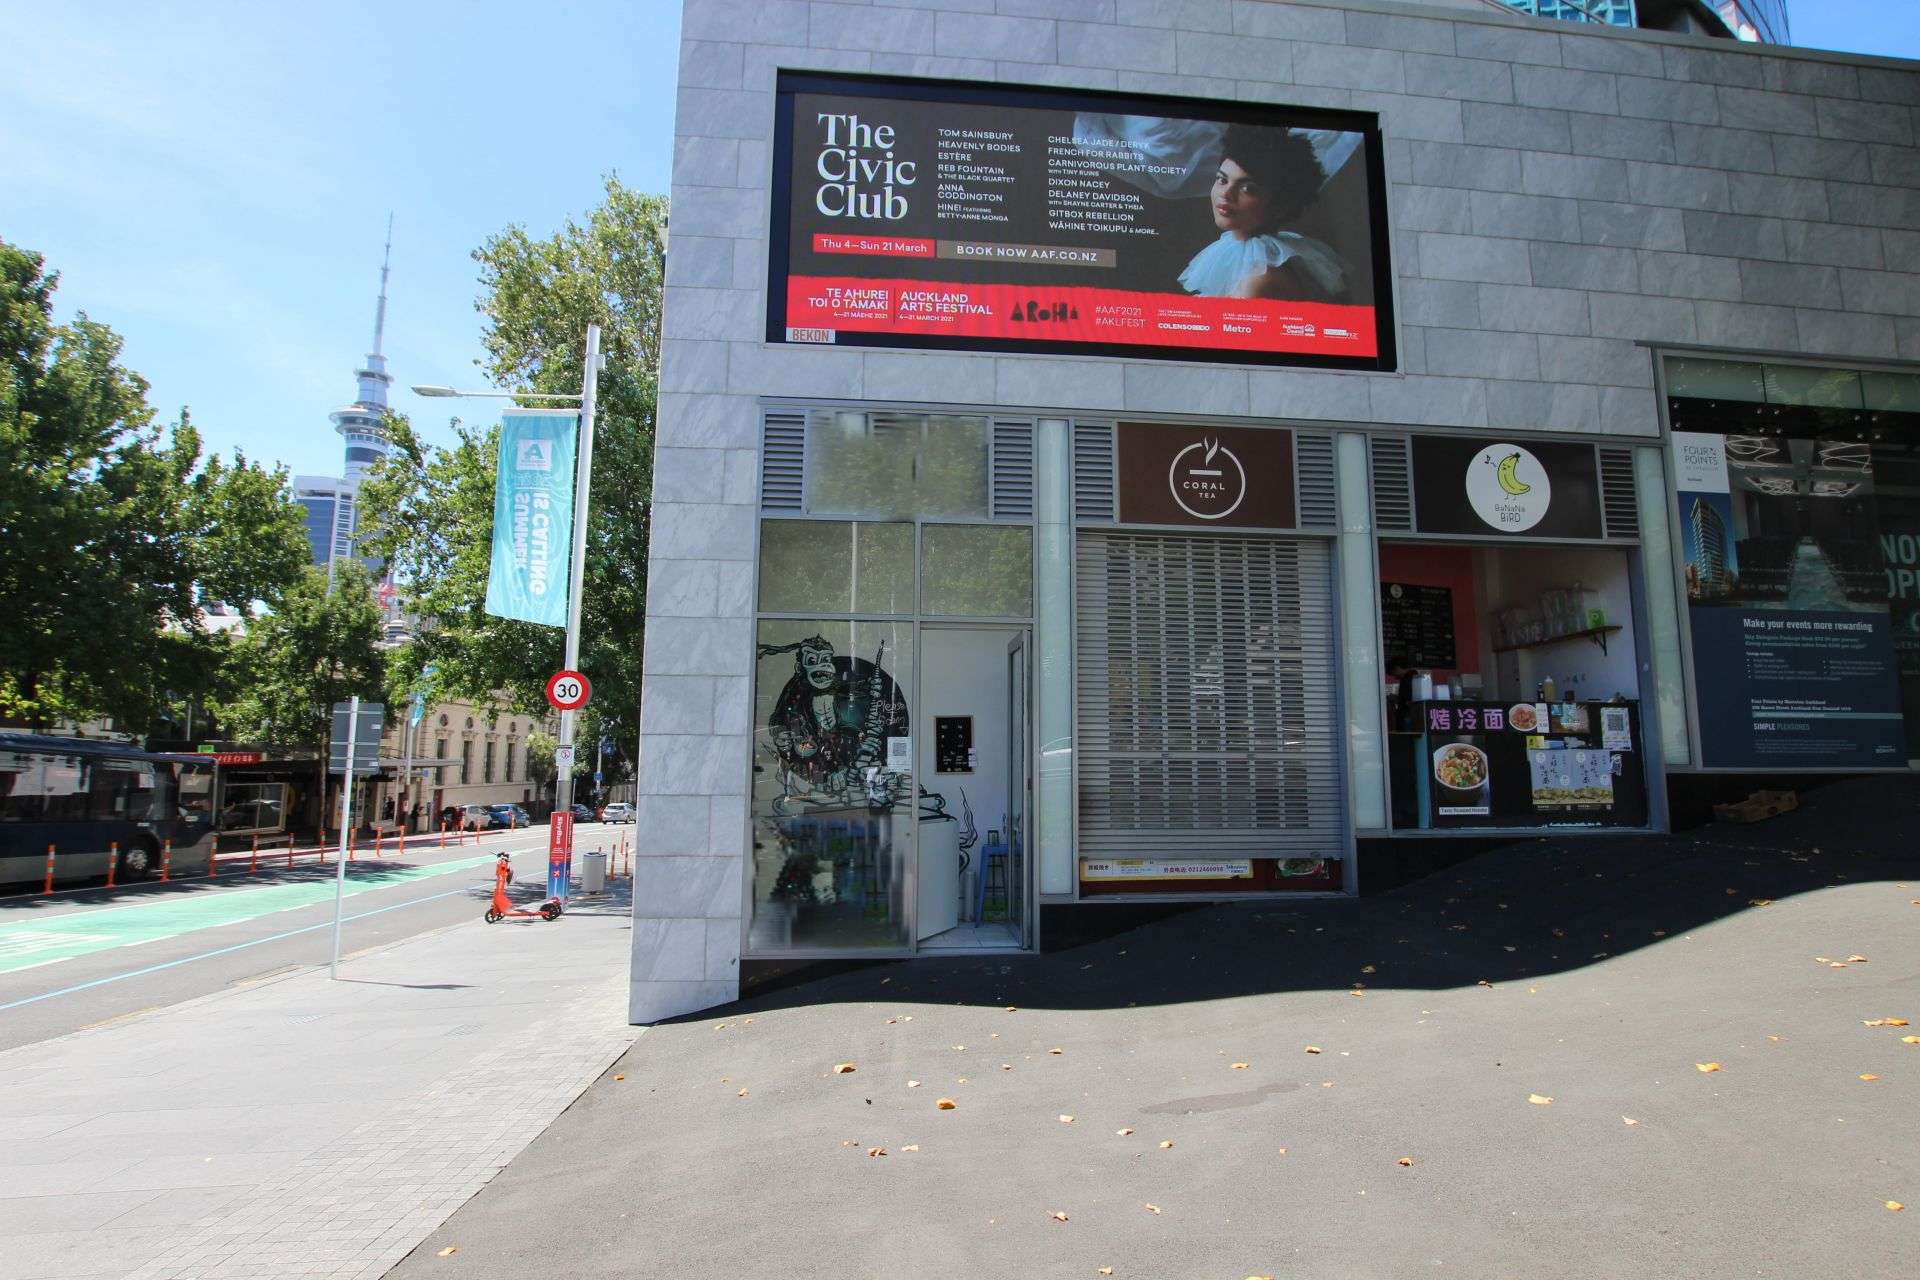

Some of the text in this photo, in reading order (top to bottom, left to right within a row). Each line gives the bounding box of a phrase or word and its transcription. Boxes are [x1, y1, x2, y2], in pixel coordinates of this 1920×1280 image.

[817, 113, 896, 149] The
[938, 128, 1014, 140] TOM SAINSBURY
[938, 141, 1021, 153] HEAVENLY BODIES
[1048, 135, 1089, 145] CHELSEA
[1091, 138, 1114, 147] JADE
[1048, 147, 1144, 160] FRENCH FOR RABBITS
[817, 148, 918, 186] Civic
[938, 164, 1005, 175] REB FOUNTAIN
[1048, 159, 1187, 175] CARNIVOROUS PLANT SOCIETY
[983, 175, 1015, 183] QUARTET
[1048, 178, 1111, 189] DIXON NACEY
[938, 184, 965, 192] ANNA
[816, 183, 909, 220] Club
[937, 191, 1003, 202] CODDINGTON
[1048, 190, 1140, 202] DELANEY DAVIDSON
[1048, 210, 1134, 221] GITBOX REBELLION
[1088, 223, 1128, 233] TOIKUPU
[821, 238, 842, 249] Thu
[882, 241, 893, 251] 21
[894, 242, 928, 253] March
[957, 245, 1097, 262] BOOK NOW AAF.CO.NZ
[826, 287, 889, 300] TE AHUREI
[900, 291, 968, 303] AUCKLAND
[808, 297, 828, 308] TOI
[900, 301, 993, 315] ARTS FESTIVAL
[1095, 305, 1143, 316] #AAF2021
[1095, 317, 1146, 328] #AKLFEST
[792, 329, 830, 341] BEKON
[1223, 324, 1252, 334] Metro
[1683, 446, 1709, 456] FOUR
[1685, 455, 1718, 466] POINTS
[1183, 481, 1226, 491] CORAL
[1199, 492, 1217, 500] TEA
[1743, 618, 1873, 633] Make your events more rewarding
[557, 683, 579, 698] 30
[1753, 723, 1777, 731] SIMPLE
[555, 815, 564, 846] SkyBus
